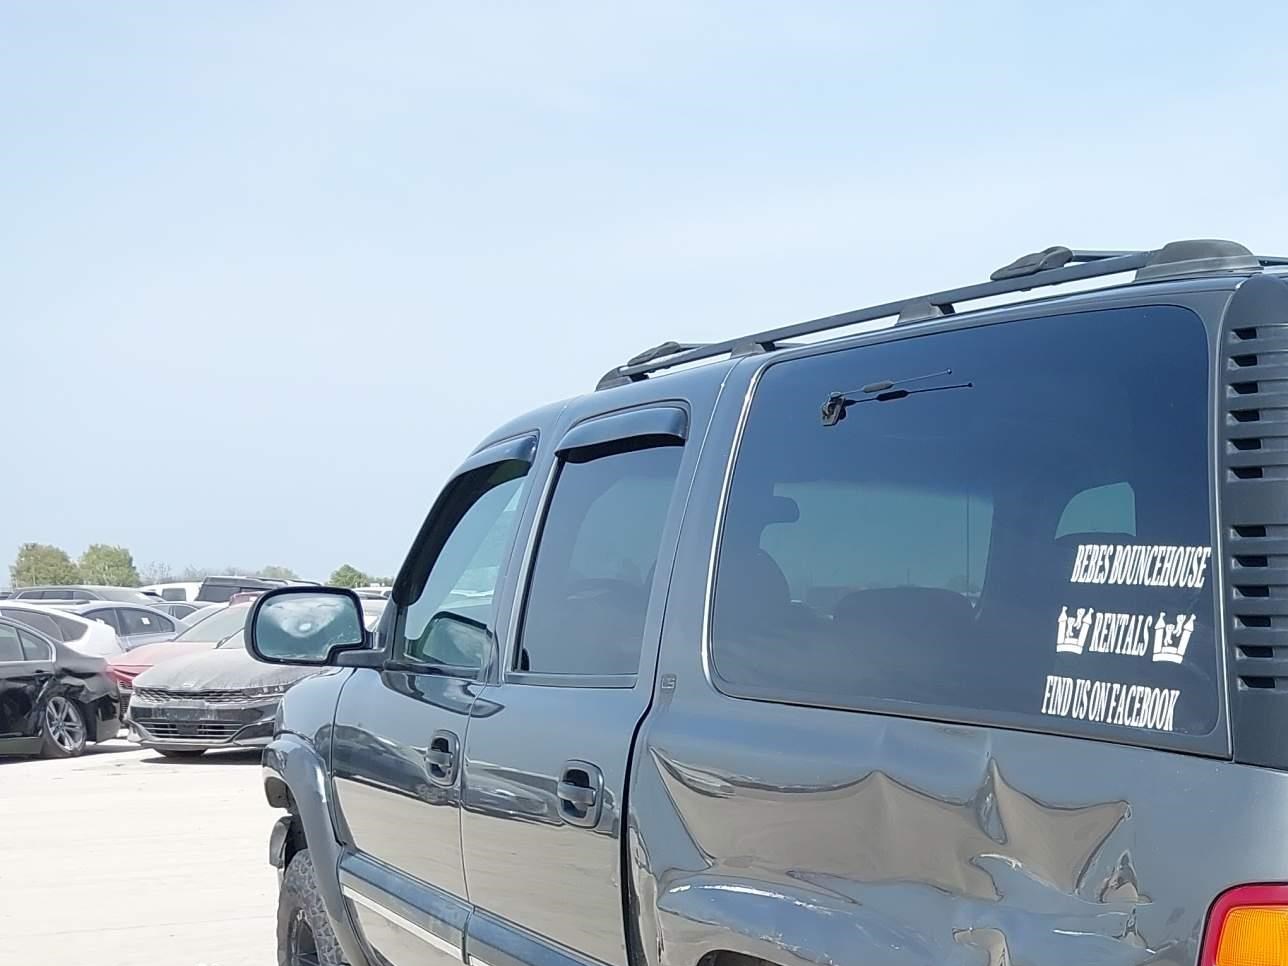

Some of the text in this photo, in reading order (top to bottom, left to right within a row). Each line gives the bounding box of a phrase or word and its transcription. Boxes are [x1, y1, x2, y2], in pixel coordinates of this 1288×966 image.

[1071, 544, 1211, 588] BEBES BOUNCEHOUSE
[1089, 612, 1152, 656] RENTALS
[1041, 675, 1180, 731] FIND US ON FACEBOOK
